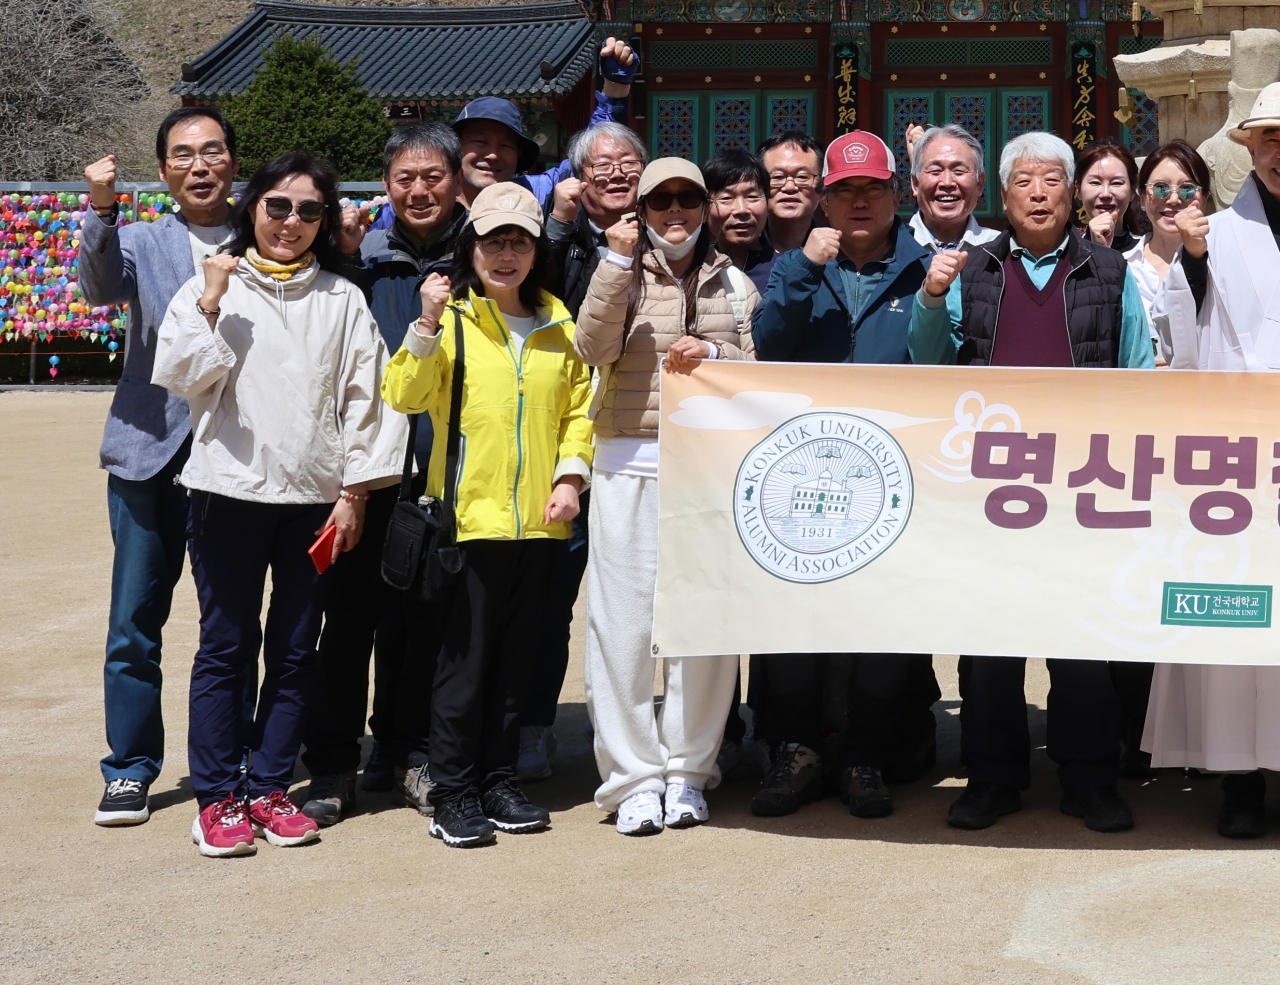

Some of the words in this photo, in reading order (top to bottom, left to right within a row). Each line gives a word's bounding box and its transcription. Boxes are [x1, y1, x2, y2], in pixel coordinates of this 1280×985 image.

[744, 423, 812, 484] KONKUK
[820, 419, 903, 490] UNIVERSITY
[742, 504, 788, 566] ALUMNI
[785, 513, 900, 574] ASSOCIATION
[800, 527, 833, 538] 1931
[1173, 593, 1211, 615] KU
[1212, 594, 1260, 608] 건국대학교
[1212, 608, 1241, 616] KONKUK
